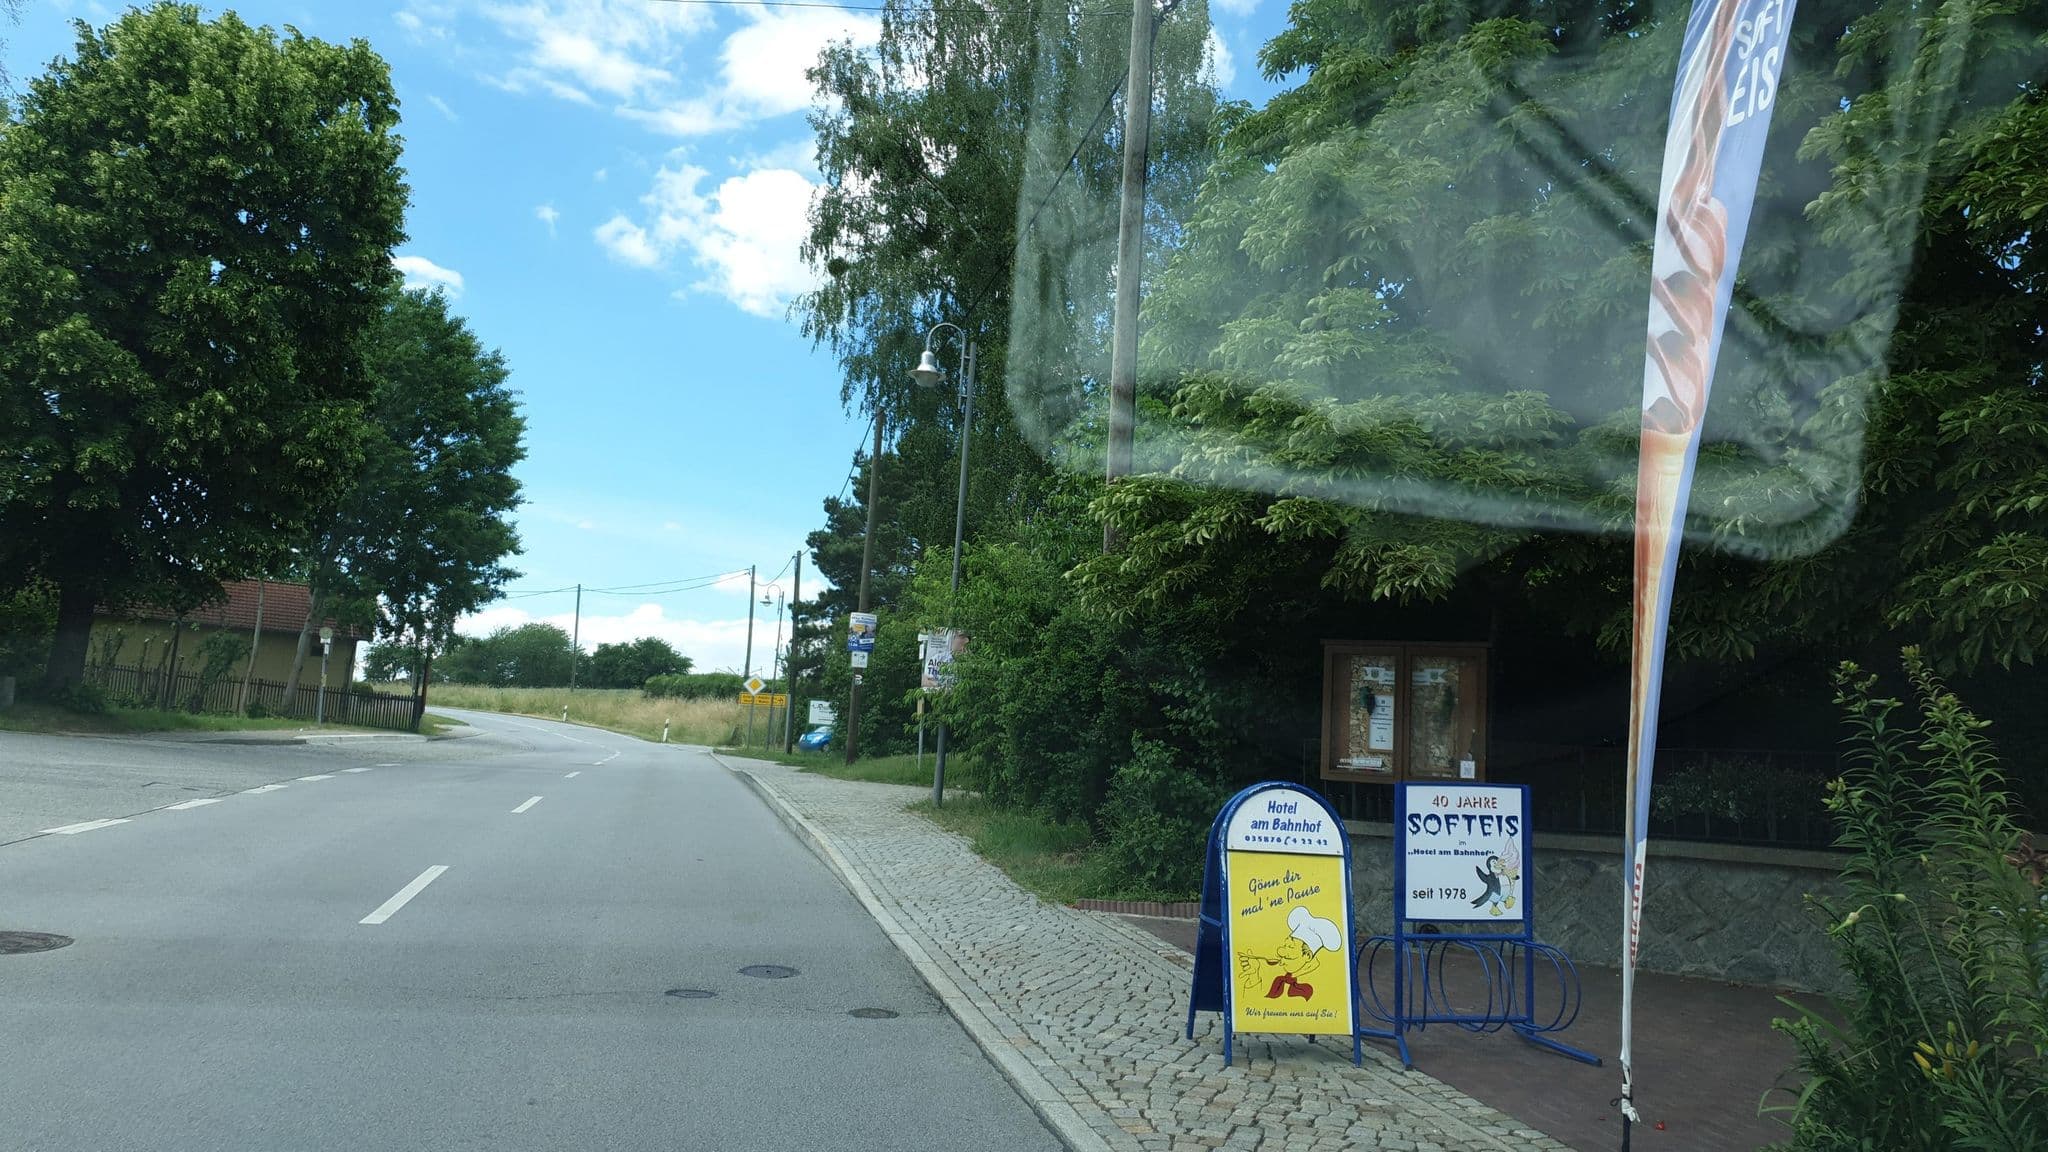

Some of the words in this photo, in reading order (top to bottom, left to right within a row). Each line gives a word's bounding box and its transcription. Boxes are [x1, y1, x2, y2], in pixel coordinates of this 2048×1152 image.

[1726, 46, 1779, 127] EIS
[1267, 800, 1298, 815] Hotel
[1432, 795, 1449, 808] 40
[1456, 796, 1498, 809] JAHRE
[1250, 819, 1269, 831] am
[1272, 817, 1322, 833] Bahnhof
[1407, 813, 1519, 837] SOFTEIS
[1248, 878, 1280, 896] Gönn
[1283, 869, 1302, 884] dir
[1241, 896, 1264, 917] mal
[1287, 885, 1321, 903] Pause
[1412, 887, 1434, 900] seit
[1439, 888, 1467, 900] 1978
[1245, 1007, 1261, 1017] Wir
[1262, 1008, 1288, 1019] freuen
[1305, 1009, 1319, 1020] auf
